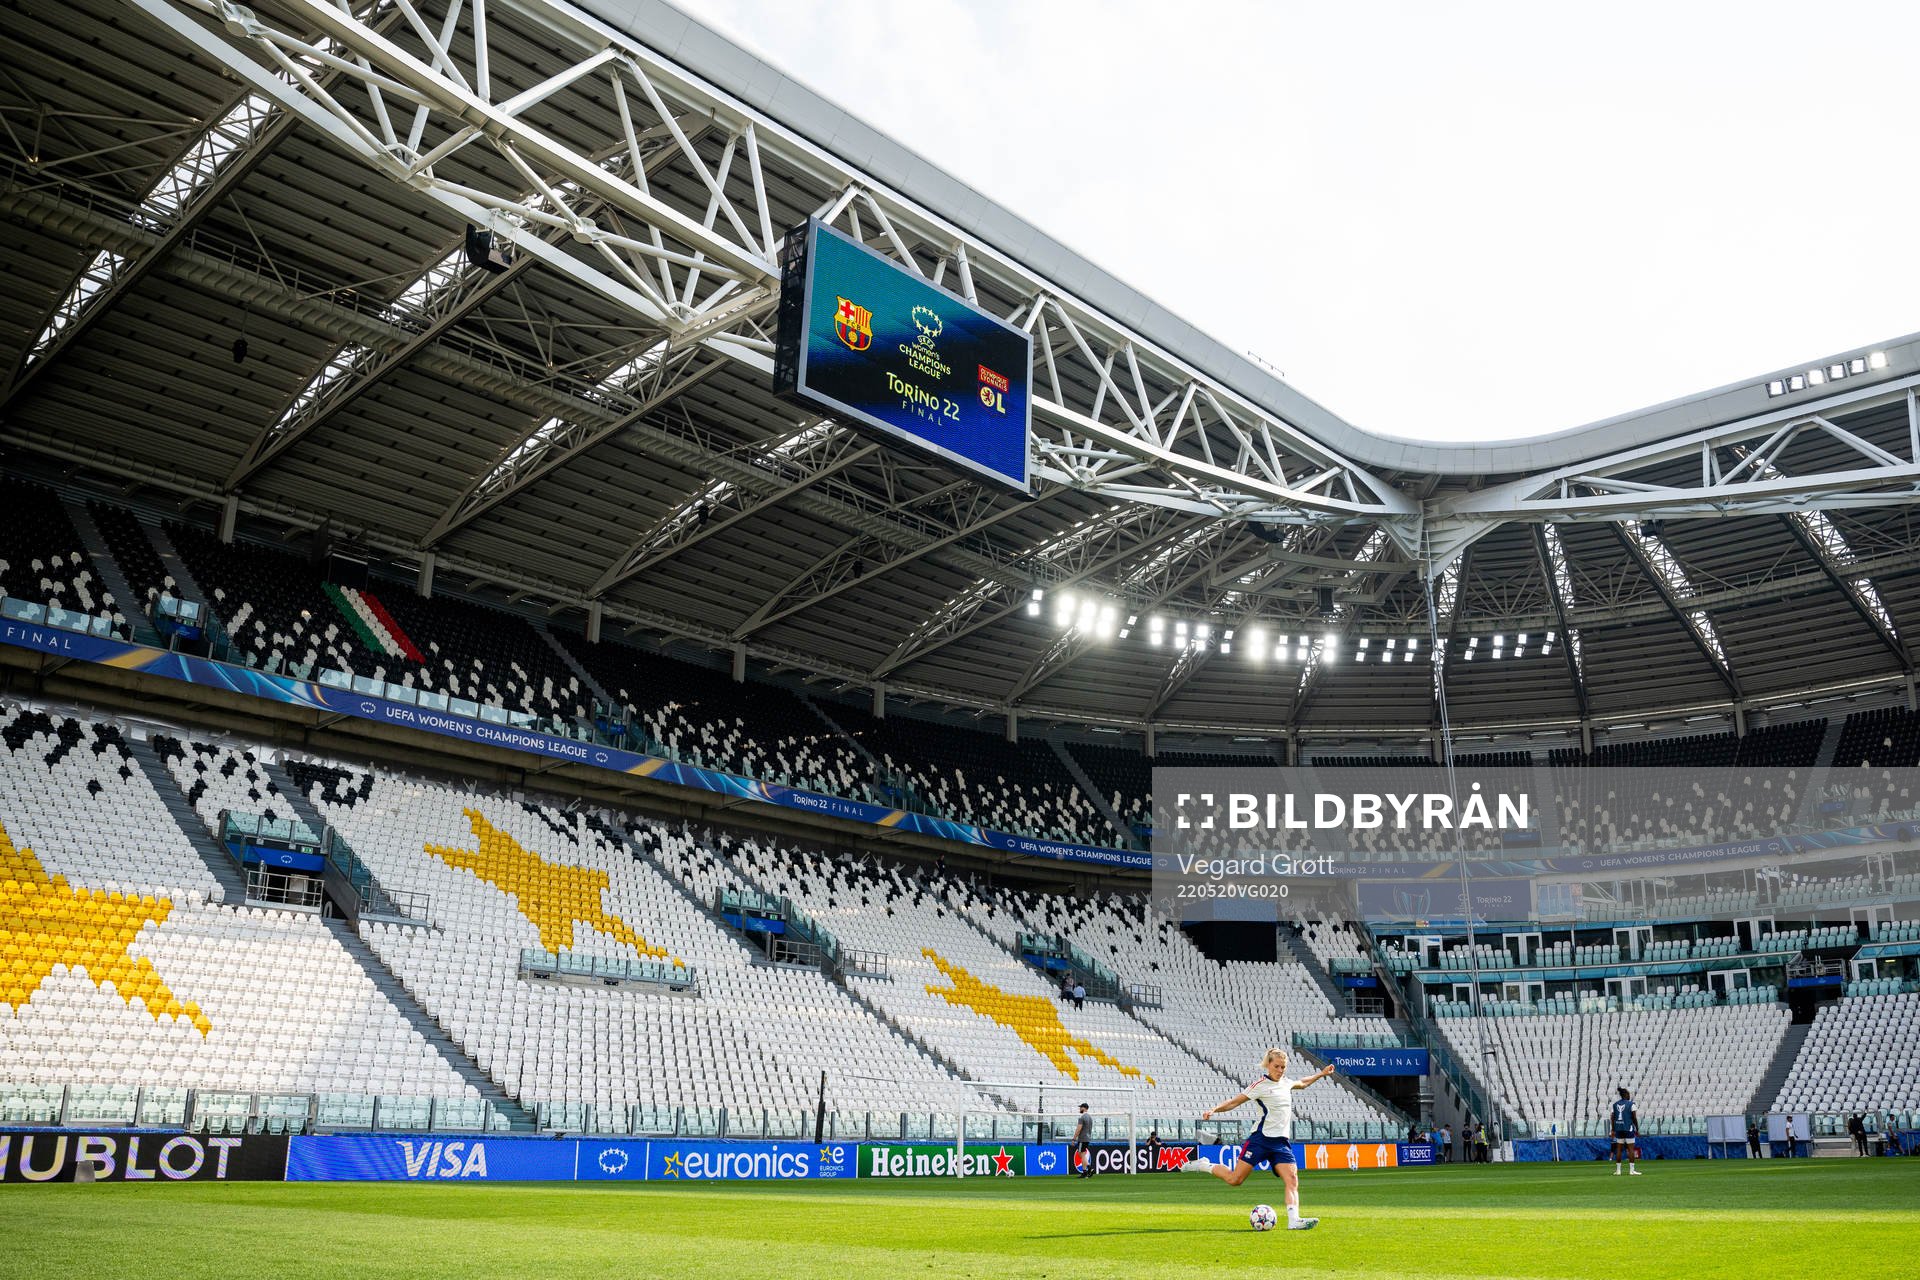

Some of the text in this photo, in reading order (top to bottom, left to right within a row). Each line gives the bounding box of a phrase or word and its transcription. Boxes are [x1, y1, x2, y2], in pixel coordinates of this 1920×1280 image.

[899, 344, 951, 375] CHAMPIONS
[909, 358, 941, 380] LEAGUE
[902, 400, 942, 426] FINAL
[943, 398, 960, 421] 22
[7, 626, 72, 650] FINAL
[386, 706, 588, 759] UEFA WOMEN'S CHAMPIONS LEAGUE
[819, 799, 828, 809] 22
[831, 803, 863, 816] FINAL
[1020, 841, 1152, 865] UEFA WOMEN'S CHAMPIONS LEAGUE
[1600, 844, 1761, 867] UEFA WOMEN'S CHAMPIONS LEAGUE
[1366, 1057, 1376, 1066] 22
[1381, 1058, 1420, 1066] FINAL
[0, 1135, 242, 1181] UBLOT
[396, 1141, 488, 1177] VISA
[683, 1145, 809, 1179] euronics
[870, 1147, 991, 1176] Heineken
[1410, 1149, 1431, 1159] RESPECT
